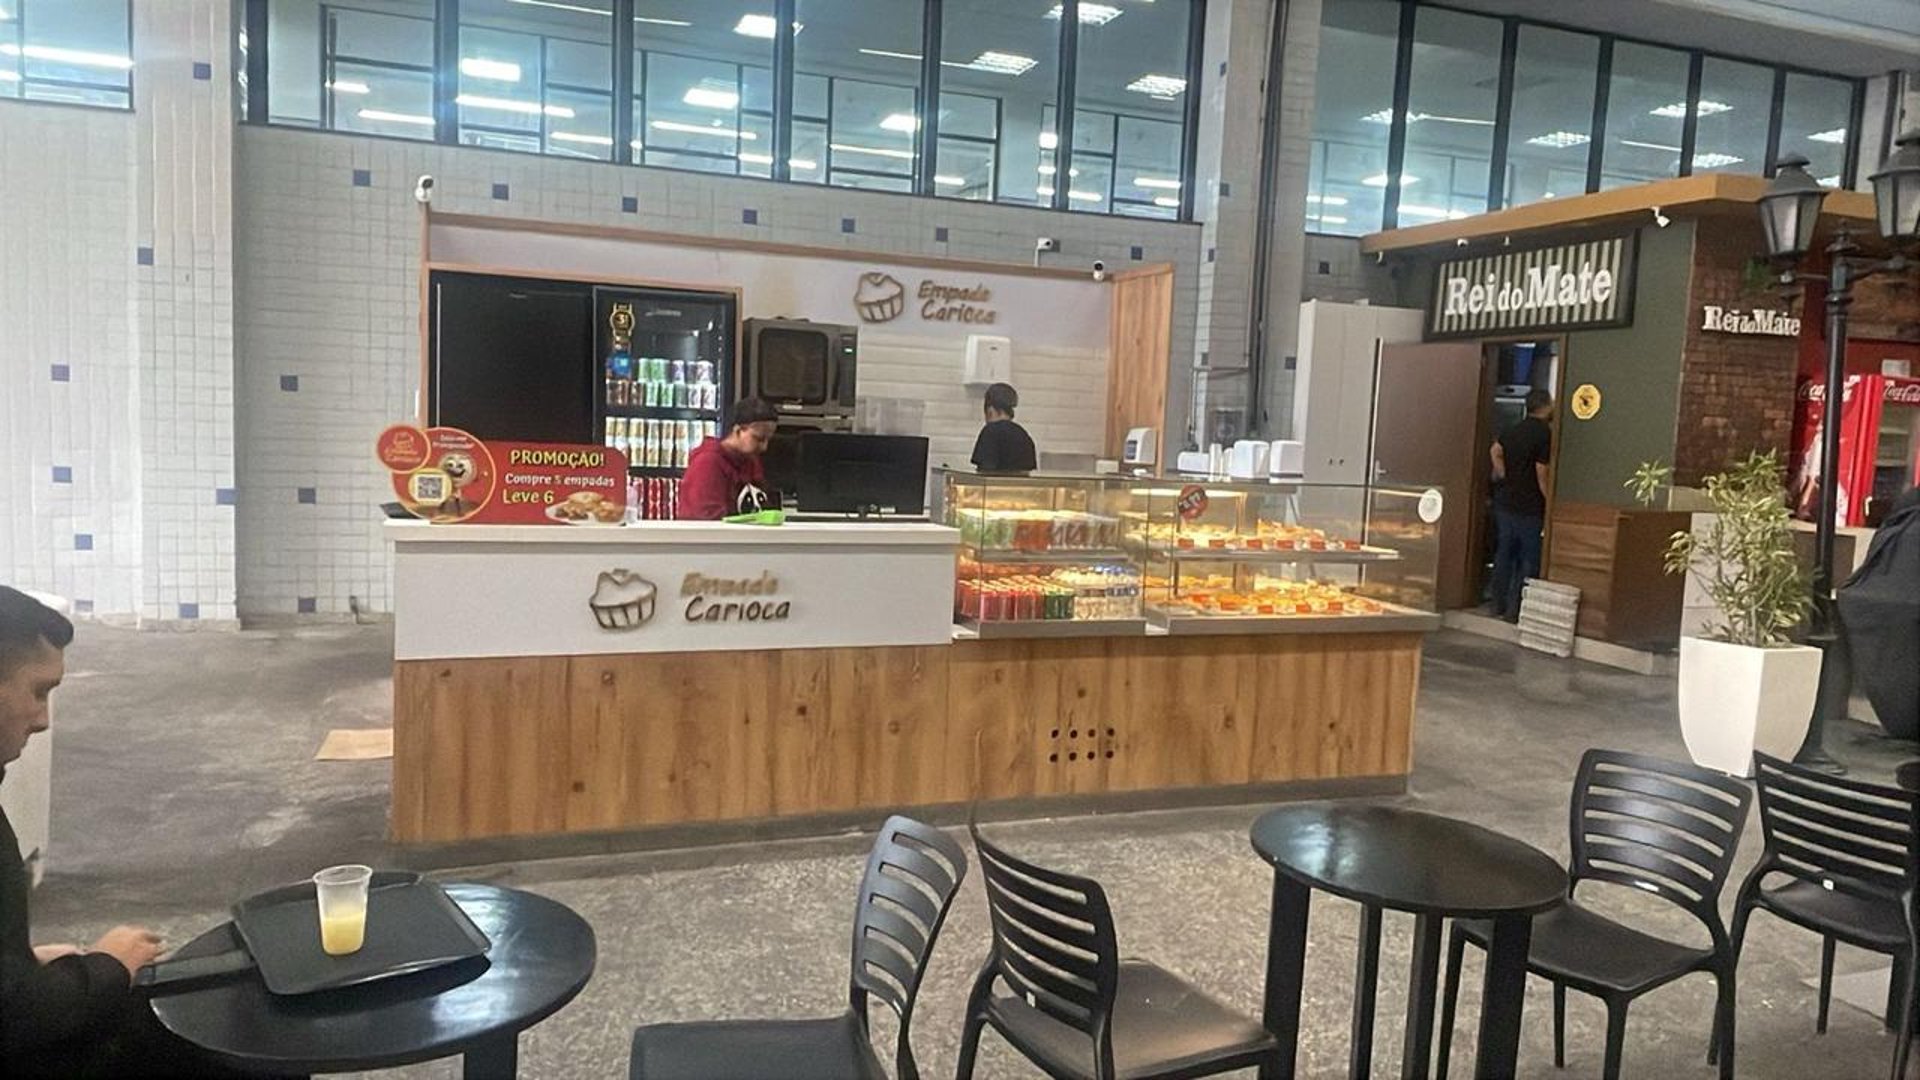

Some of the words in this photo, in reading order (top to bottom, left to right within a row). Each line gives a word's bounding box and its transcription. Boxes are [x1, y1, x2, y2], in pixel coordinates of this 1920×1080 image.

[1445, 273, 1495, 316] Rei
[1498, 281, 1524, 311] do
[1525, 261, 1612, 309] Mate
[921, 299, 997, 324] Carioca
[1702, 305, 1741, 333] Rei
[505, 472, 552, 486] Compre
[564, 475, 615, 488] empadas
[503, 488, 540, 504] Leve
[543, 490, 554, 504] 6
[684, 596, 791, 622] Carioca
